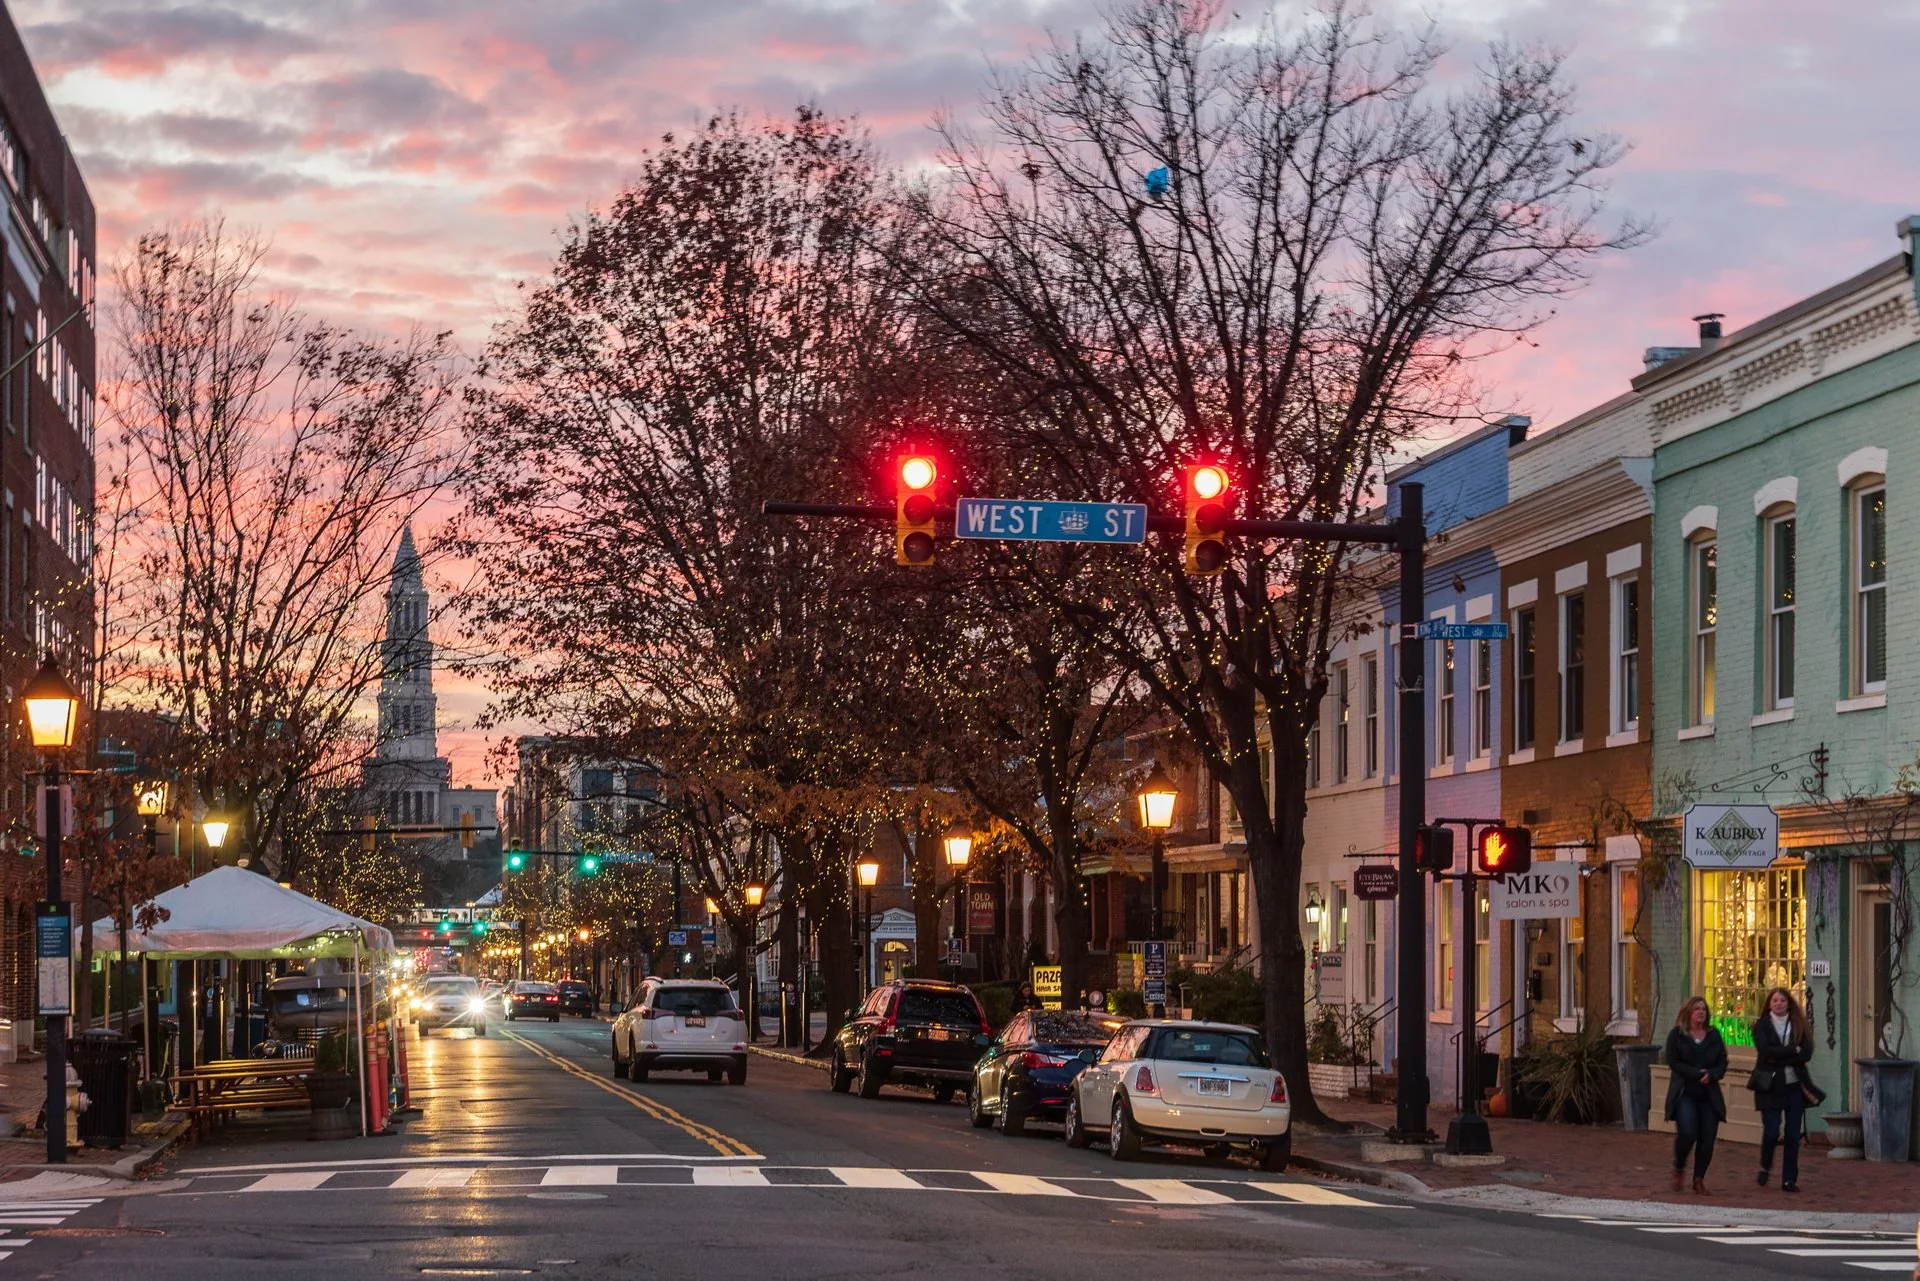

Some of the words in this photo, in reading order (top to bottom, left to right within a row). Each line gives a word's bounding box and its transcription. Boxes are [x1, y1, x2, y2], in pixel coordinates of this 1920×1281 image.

[967, 504, 1043, 534] WEST
[1104, 508, 1137, 537] ST
[1695, 827, 1706, 840] K
[1710, 827, 1767, 840] AUBREY
[974, 892, 991, 902] OLD
[970, 901, 994, 910] TOWN
[1506, 899, 1536, 909] salon
[1549, 898, 1569, 909] spa
[1151, 943, 1158, 954] P
